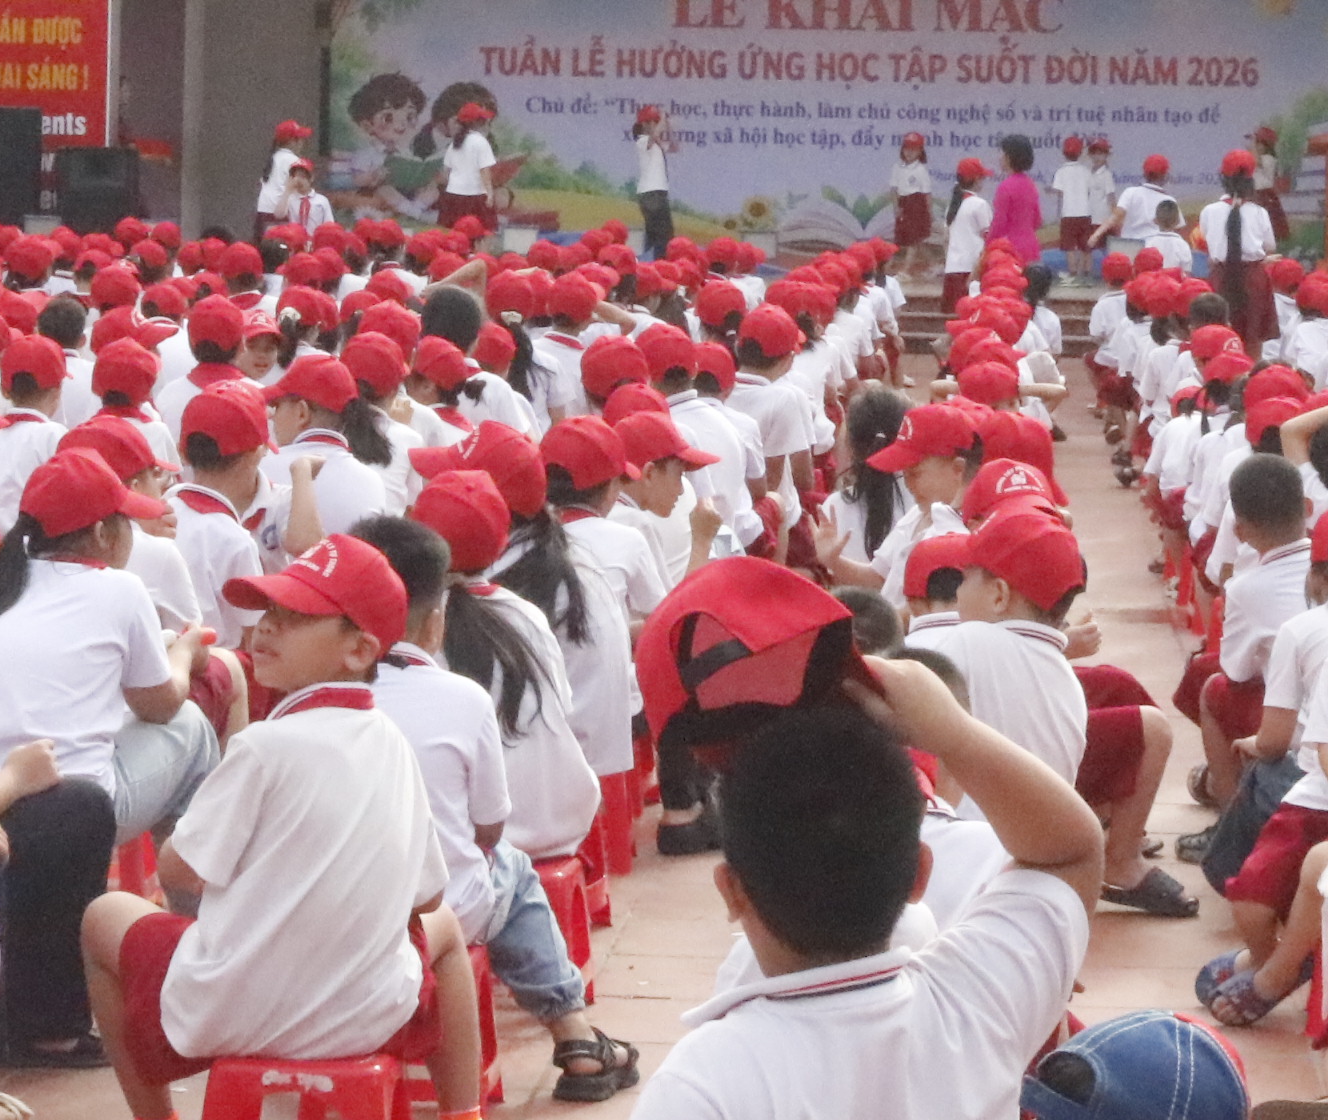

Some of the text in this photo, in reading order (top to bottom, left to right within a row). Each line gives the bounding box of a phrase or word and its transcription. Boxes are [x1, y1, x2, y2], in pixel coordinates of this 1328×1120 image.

[32, 17, 83, 51] ĐƯỢC
[27, 56, 78, 91] SÁNG
[480, 34, 1260, 91] TUẦN LỄ HƯỞNG ỨNG HỌC TẬP SUỐT ĐỜI NĂM 2026
[525, 95, 564, 115] Chủ
[713, 100, 754, 120] thực
[760, 101, 811, 121] hành,
[818, 102, 851, 120] làm
[858, 102, 892, 120] chủ
[897, 104, 940, 124] công
[946, 104, 990, 126] nghệ
[997, 99, 1015, 121] số
[1022, 105, 1042, 121] và
[1049, 103, 1071, 121] trí
[1077, 105, 1105, 126] tuệ
[1112, 105, 1158, 123] nhân
[1165, 107, 1193, 127] tạo
[1199, 101, 1221, 124] để
[712, 127, 733, 143] xã
[739, 127, 767, 146] hội
[774, 129, 804, 148] học
[852, 125, 884, 151] đẩy
[950, 132, 983, 151] học
